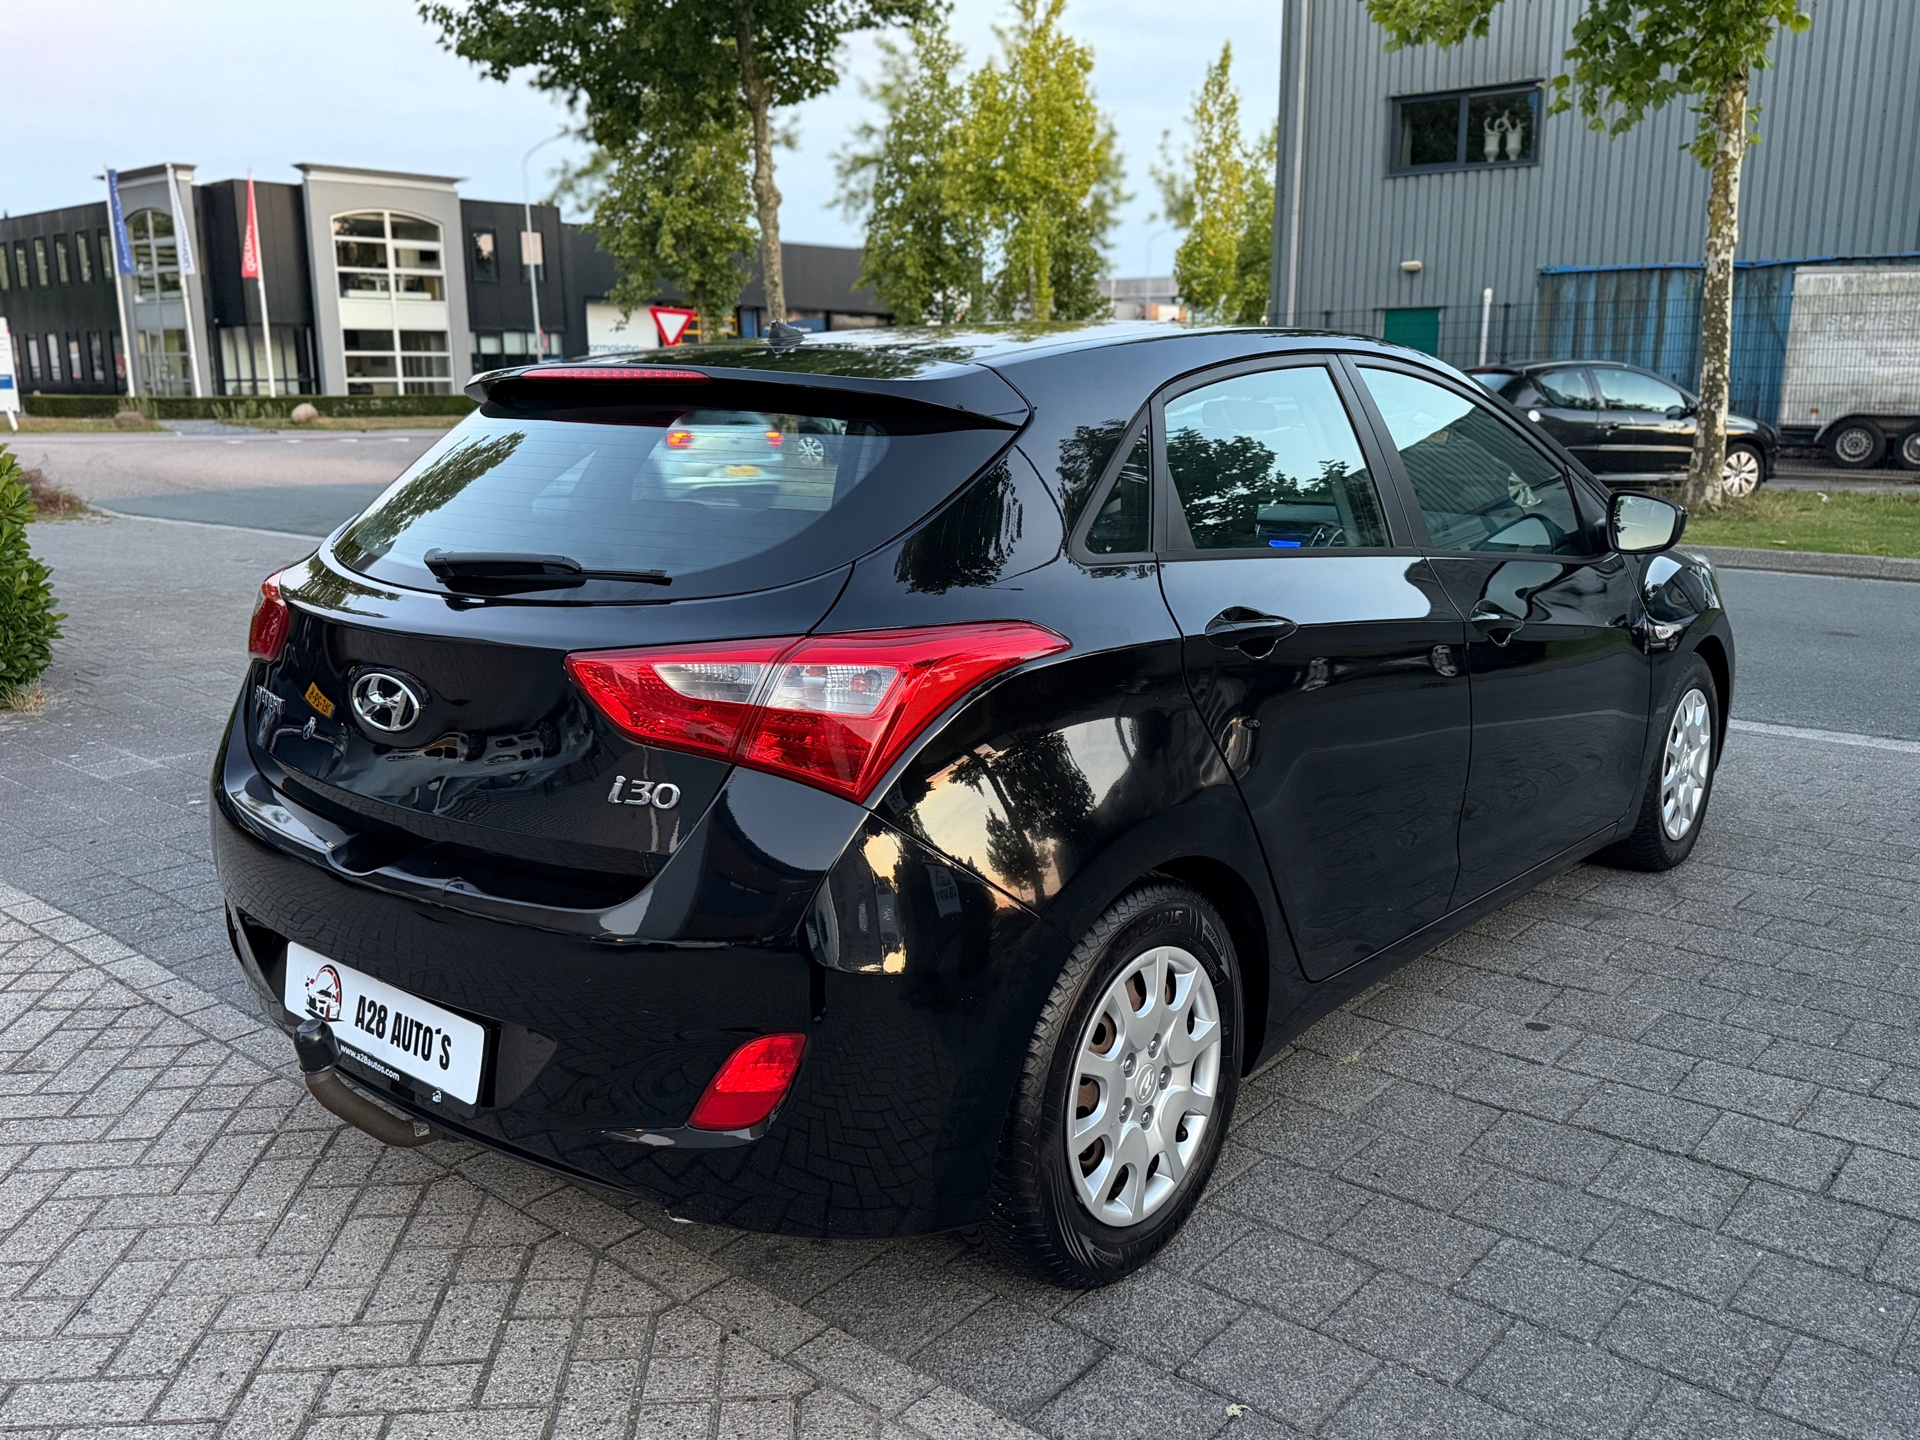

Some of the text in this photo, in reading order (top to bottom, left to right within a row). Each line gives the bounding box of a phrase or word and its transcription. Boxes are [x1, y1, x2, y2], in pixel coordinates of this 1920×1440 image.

[607, 775, 681, 809] i30
[354, 994, 389, 1040] A28
[340, 1043, 400, 1082] www.a28autos.com
